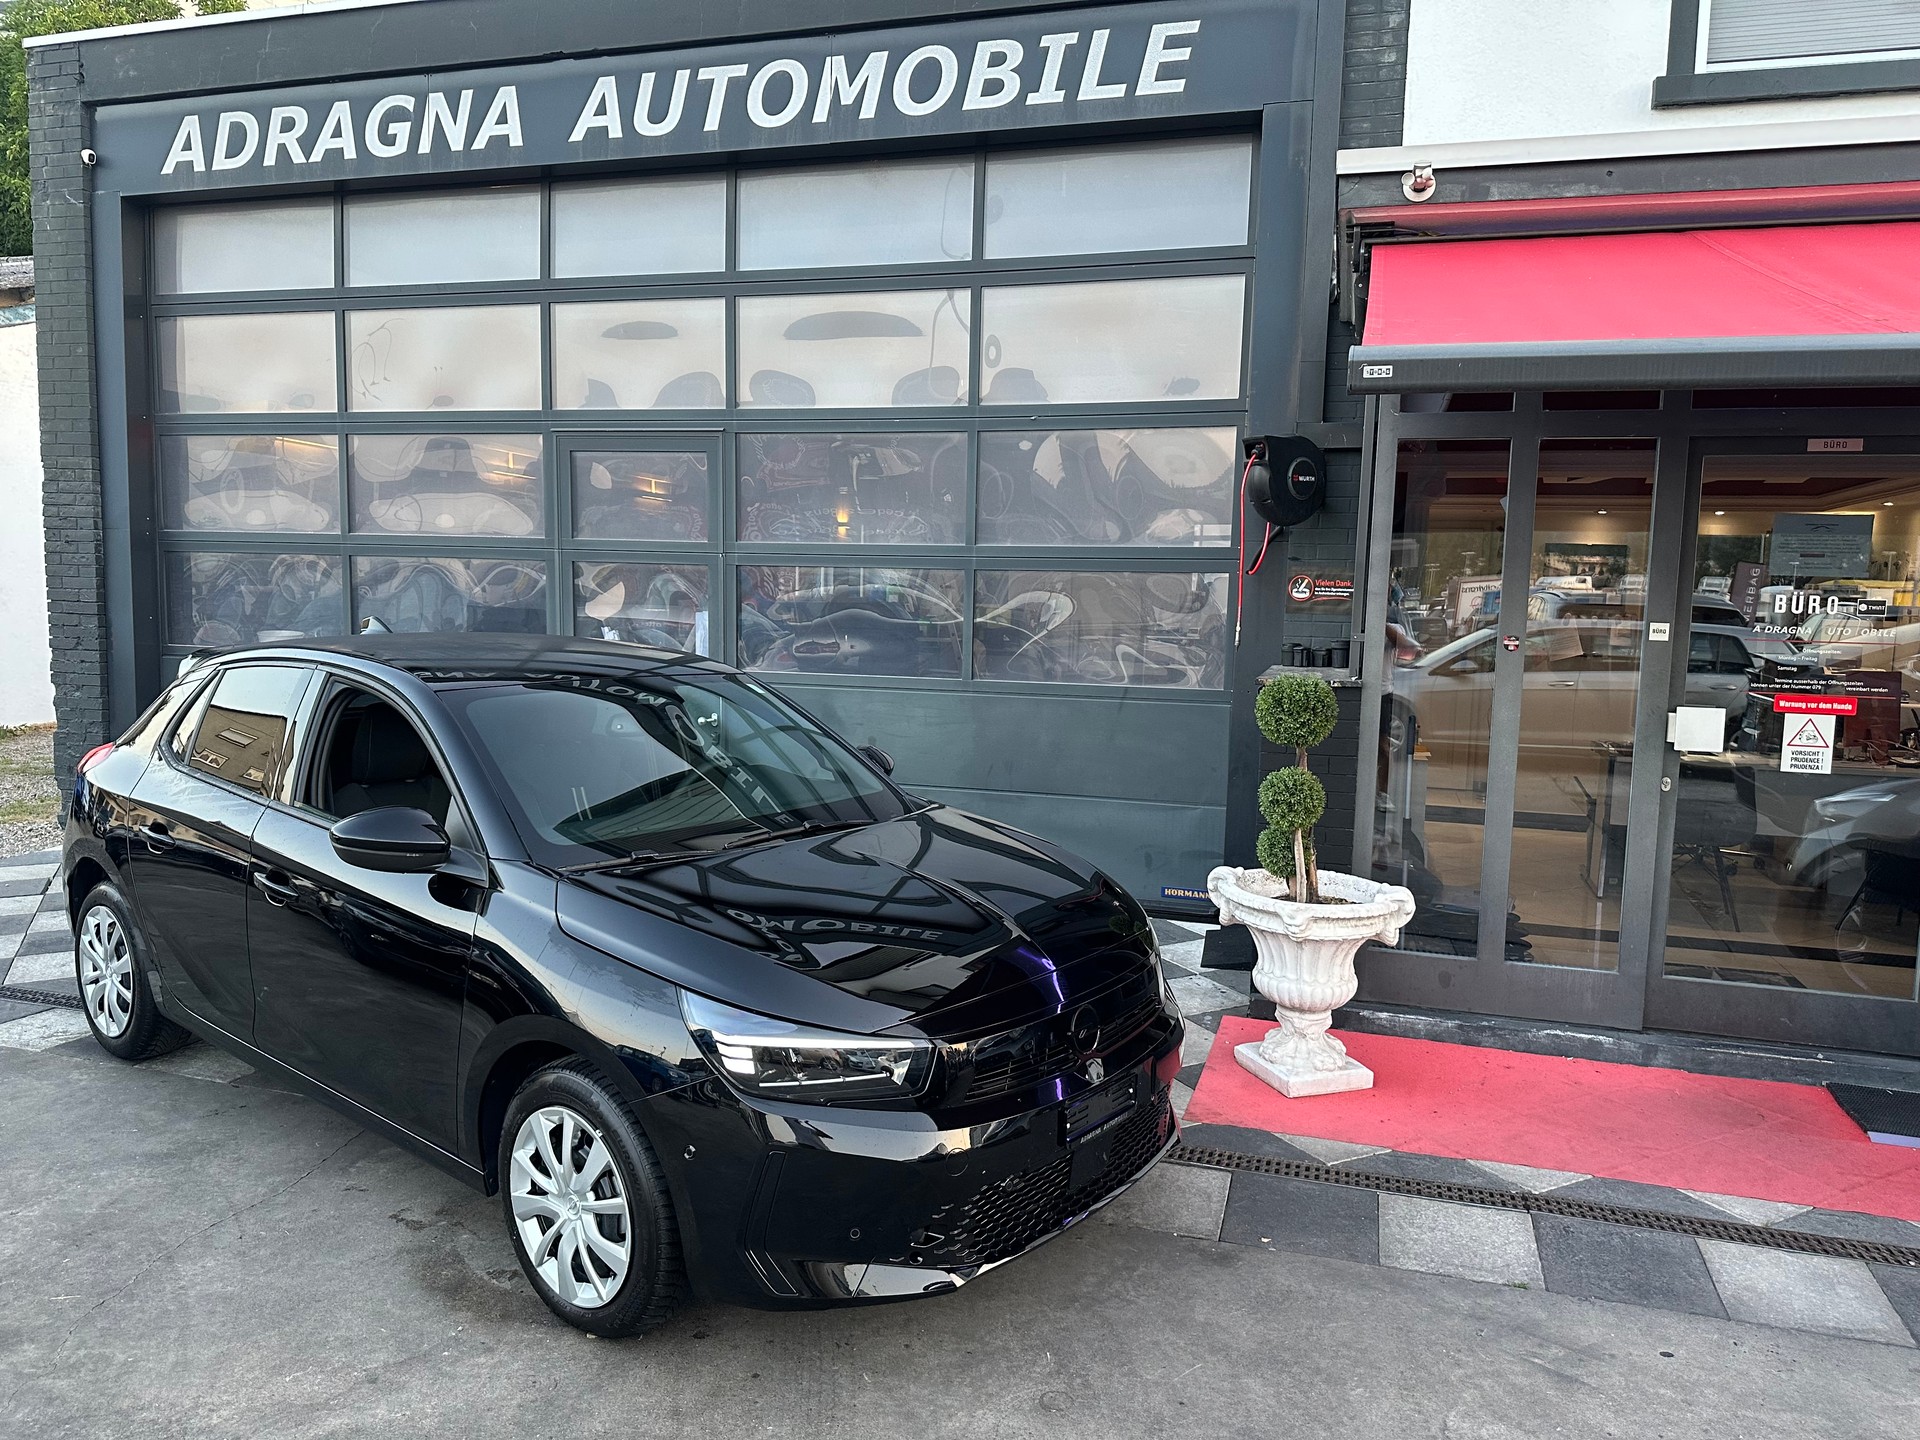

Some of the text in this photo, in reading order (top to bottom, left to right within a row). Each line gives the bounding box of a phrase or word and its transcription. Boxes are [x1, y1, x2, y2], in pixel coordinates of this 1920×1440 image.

[161, 20, 1201, 175] ADRAGNA AUTOMOBILE
[1823, 440, 1848, 449] BÜRO
[1315, 579, 1335, 587] Vielen
[1775, 591, 1839, 615] BÜRO
[1779, 700, 1853, 710] Warnung vor dem Hunde
